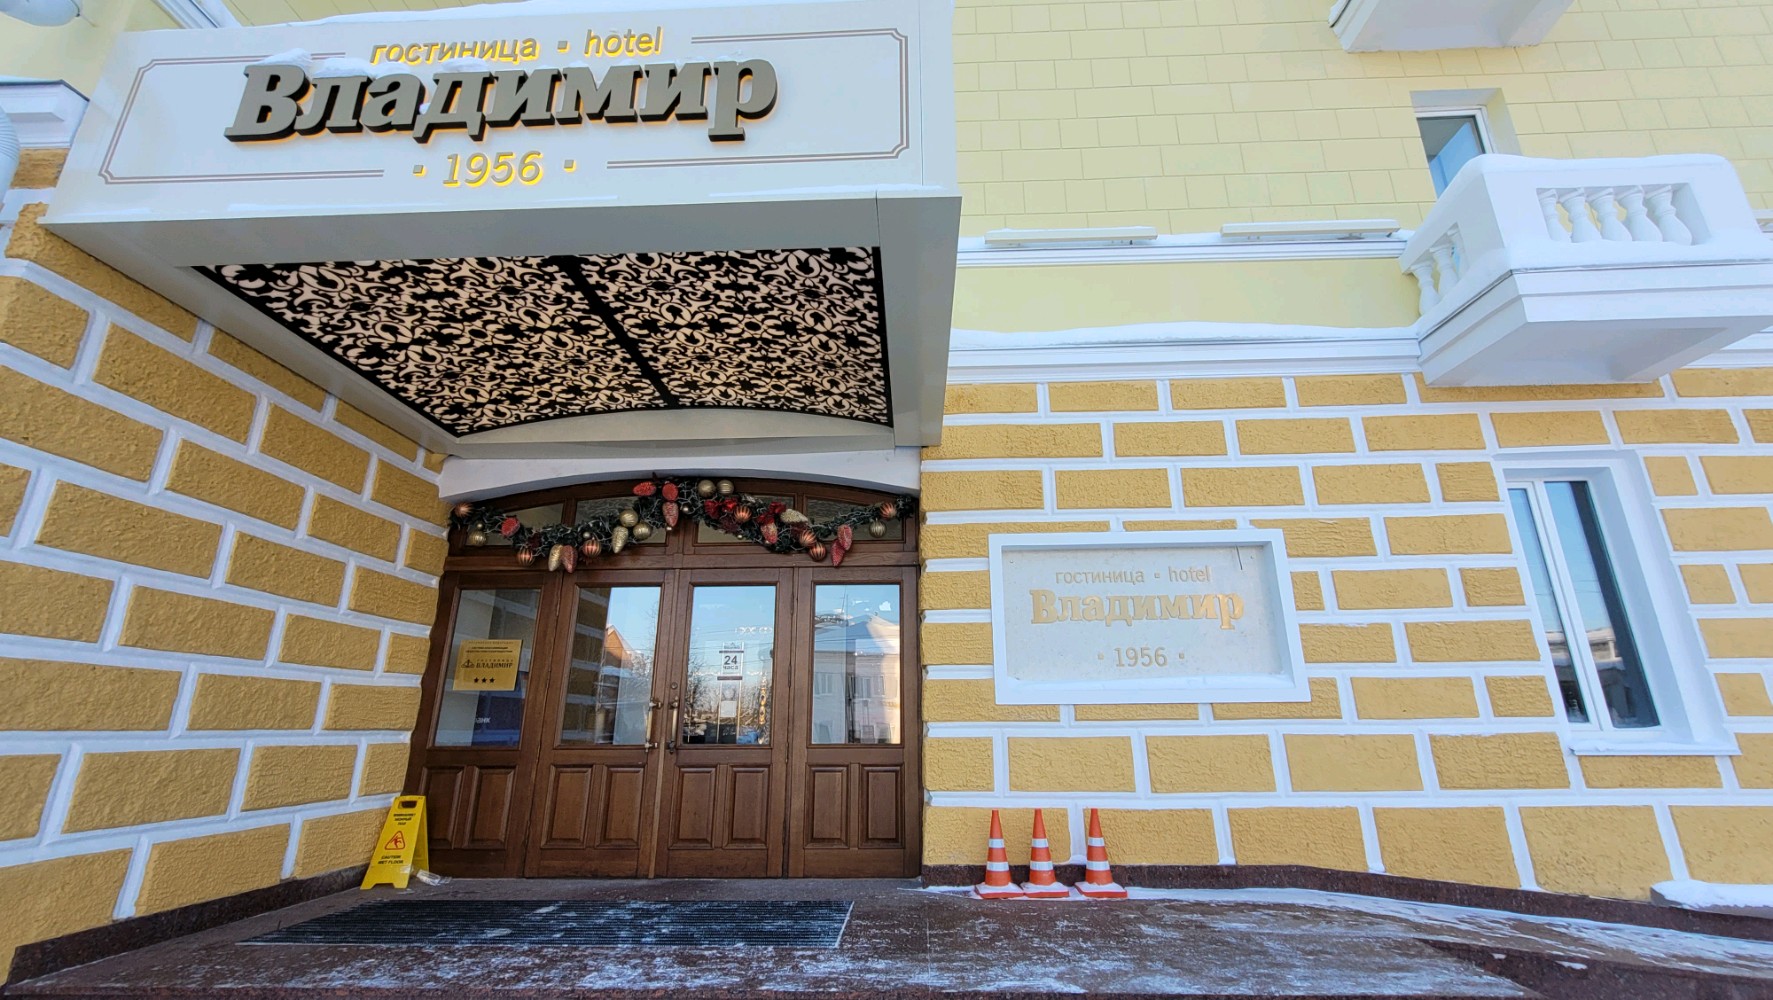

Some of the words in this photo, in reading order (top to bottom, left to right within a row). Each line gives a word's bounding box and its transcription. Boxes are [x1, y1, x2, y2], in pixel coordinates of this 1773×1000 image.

[370, 37, 540, 64] гостиница
[584, 26, 663, 56] hotel
[224, 58, 779, 144] Владимир
[442, 150, 544, 186] 1956
[1055, 567, 1145, 585] гостиница
[1168, 565, 1212, 583] hotel
[1029, 588, 1245, 630] Владимир
[724, 655, 738, 665] 24
[1114, 646, 1169, 668] 1956
